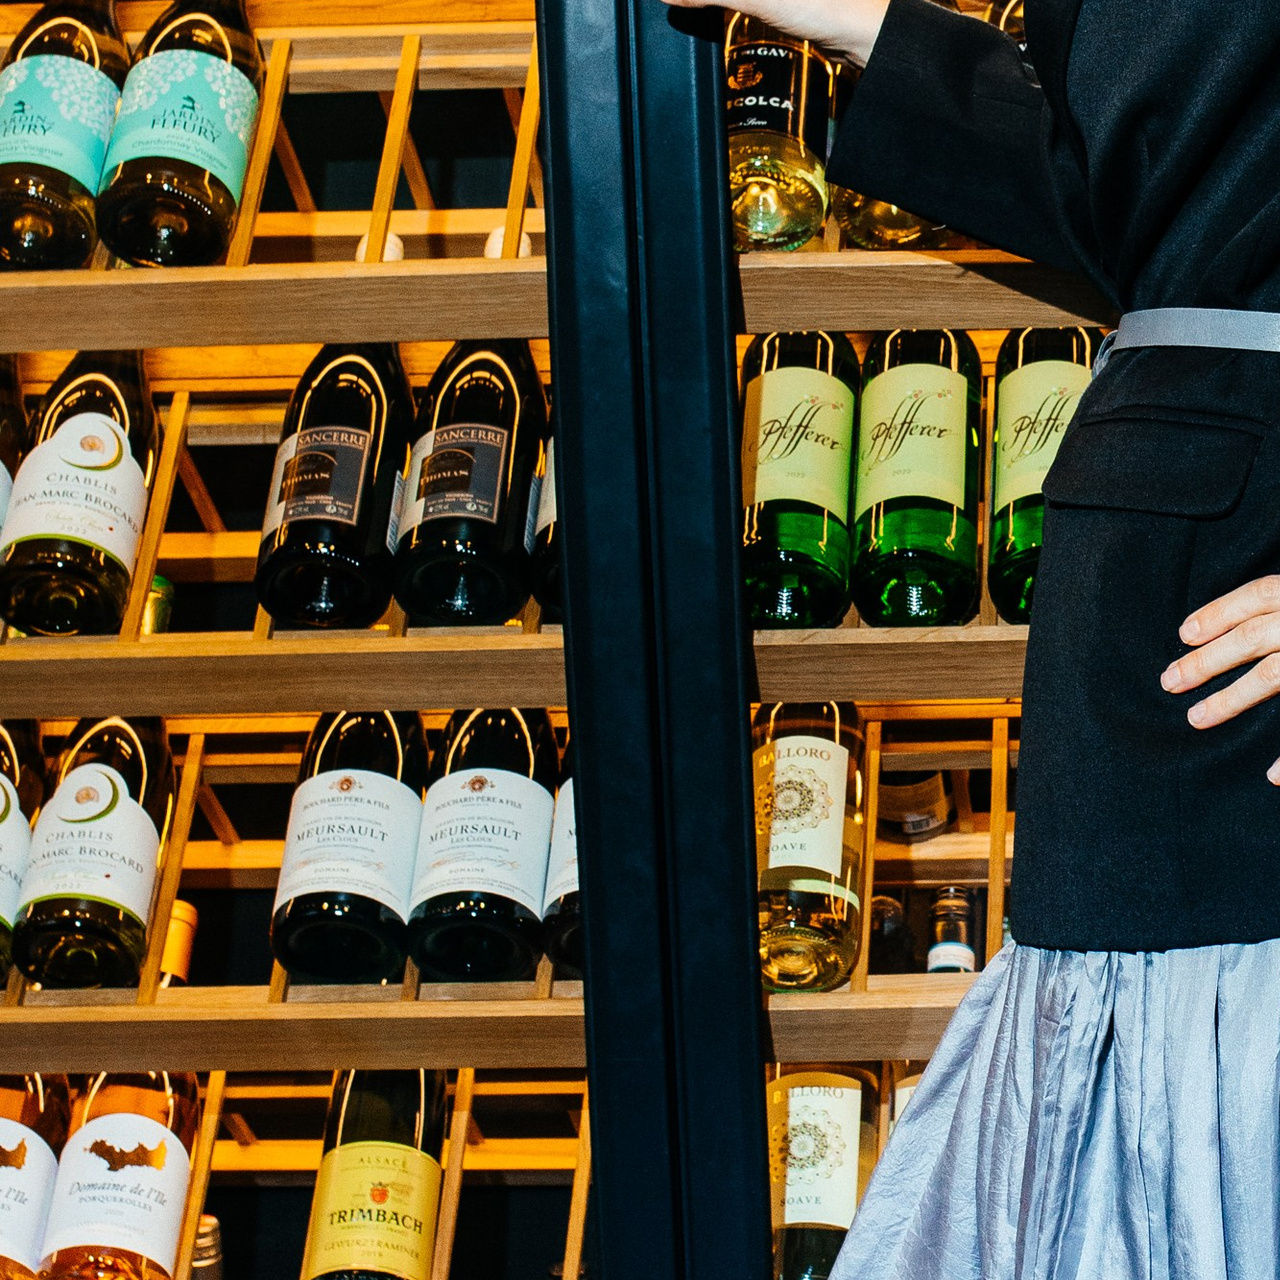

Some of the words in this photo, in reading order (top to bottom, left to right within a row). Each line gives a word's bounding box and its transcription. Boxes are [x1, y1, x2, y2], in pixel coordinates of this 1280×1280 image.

[756, 46, 794, 60] GAVI
[161, 108, 217, 129] JARDIN
[151, 118, 221, 144] FLEURY
[435, 428, 504, 445] SANCERRE
[752, 398, 845, 465] Pfefferer
[864, 391, 957, 464] Pfefferer
[298, 430, 367, 447] SANCERRE
[46, 472, 118, 497] CHABLIS
[281, 471, 331, 489] THOMAS
[419, 469, 470, 487] THOMAS
[40, 489, 80, 501] MARC
[83, 492, 139, 534] BROCARD
[45, 829, 114, 844] CHABLIS
[296, 822, 389, 843] MEURSAULT
[428, 822, 523, 846] MEURSAULT
[78, 845, 144, 874] BROCARD
[359, 1156, 408, 1168] ALSACE
[68, 1179, 128, 1196] Domaine
[129, 1183, 146, 1197] de
[329, 1207, 424, 1235] TRIMBACH
